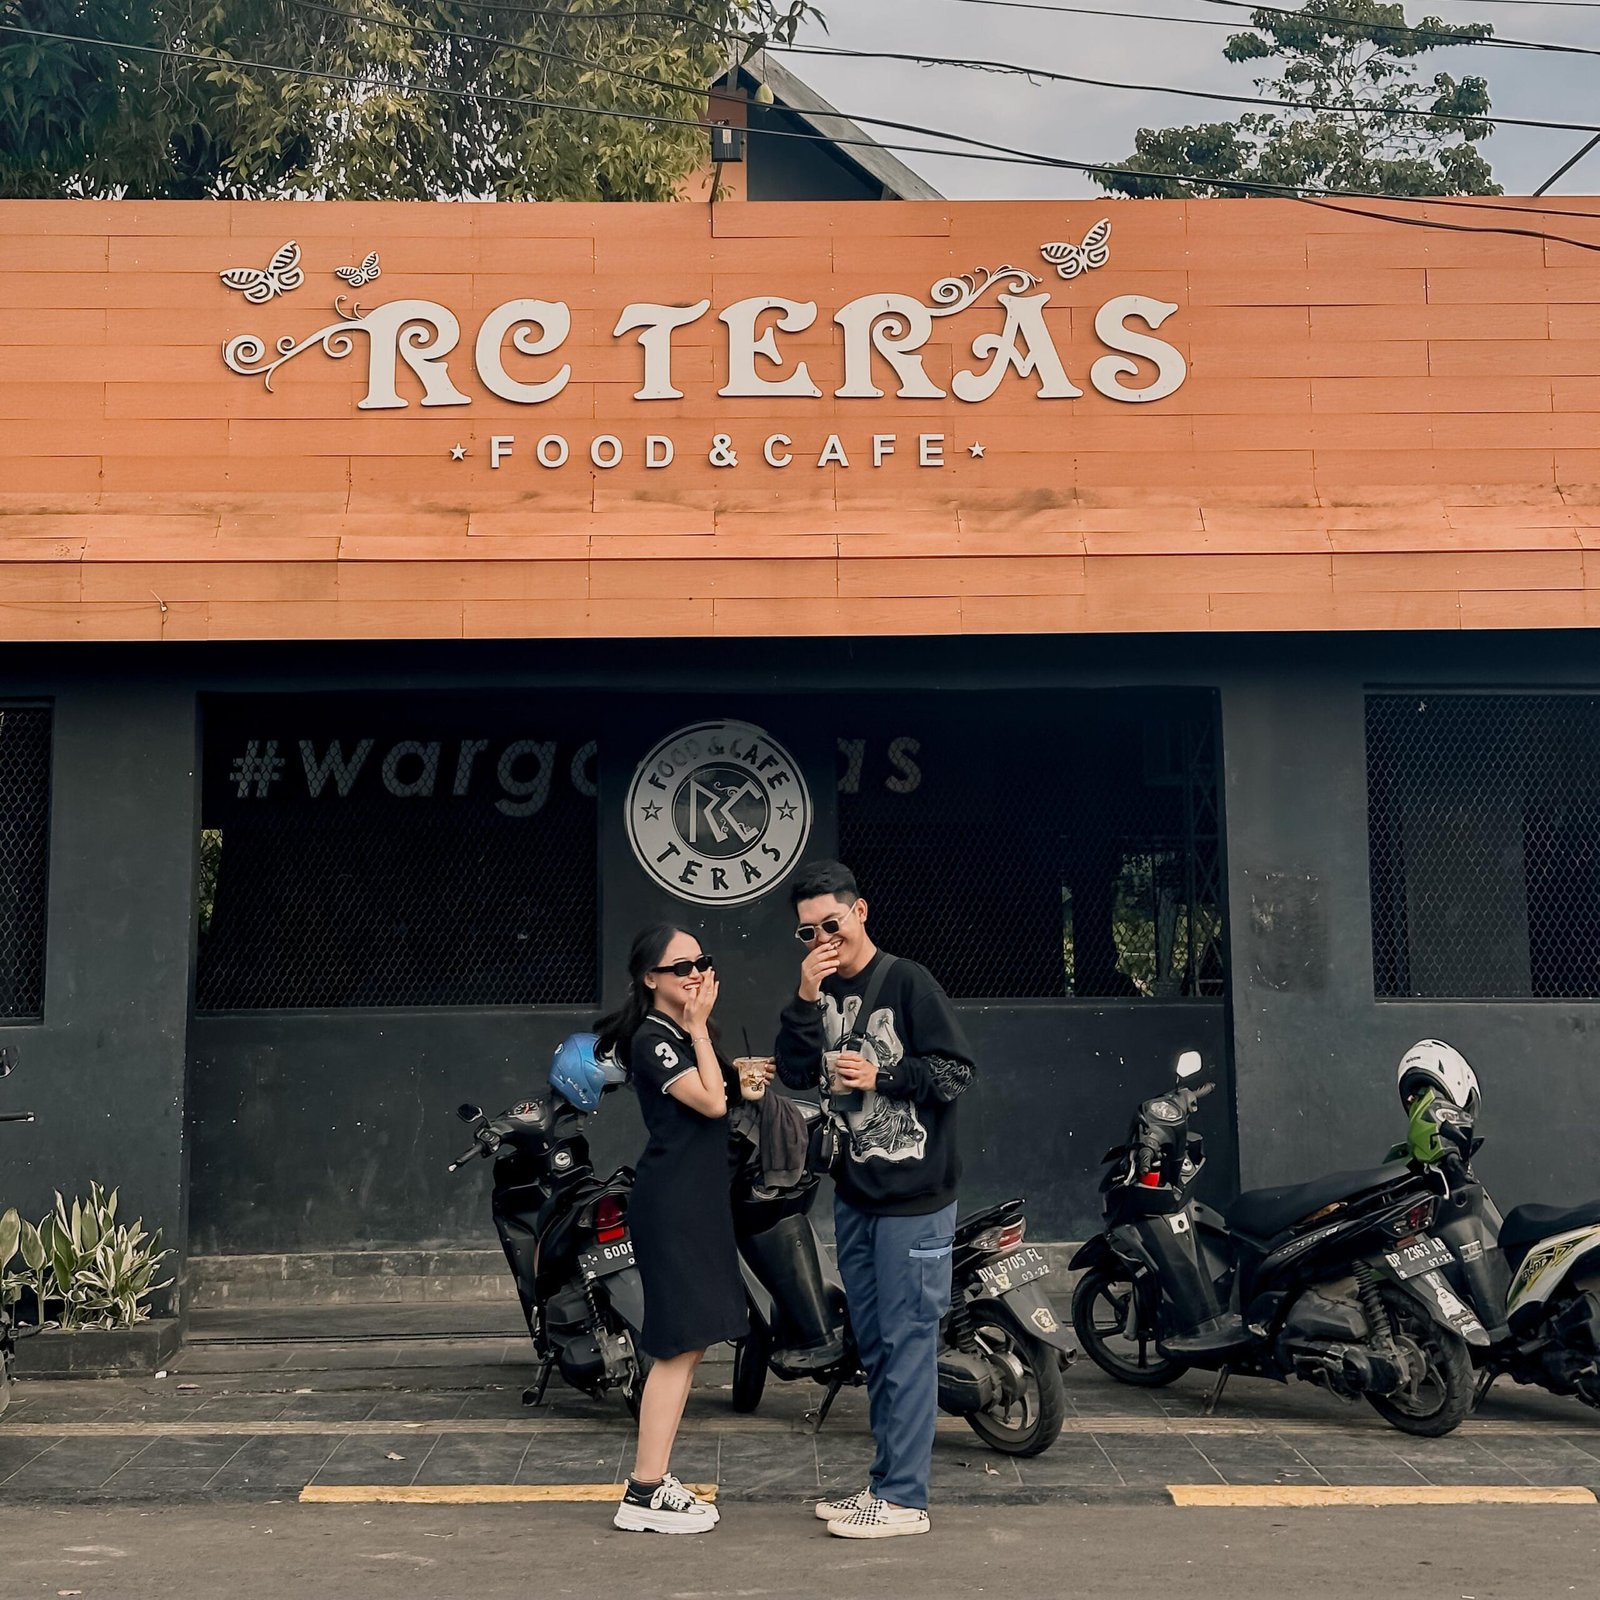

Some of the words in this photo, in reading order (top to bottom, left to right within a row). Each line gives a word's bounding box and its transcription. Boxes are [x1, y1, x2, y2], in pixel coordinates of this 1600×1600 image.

[357, 297, 572, 409] RC
[612, 293, 1188, 404] TERAS
[490, 433, 676, 469] FOOD
[708, 433, 739, 468] &
[762, 433, 946, 468] CAFE
[647, 738, 702, 792] FOOD
[729, 736, 791, 791] CAFE
[688, 779, 764, 844] RC
[656, 841, 782, 891] TERAS
[654, 1041, 679, 1069] 3
[997, 1252, 1027, 1274] 6705
[1025, 1247, 1043, 1263] FL
[1403, 1242, 1431, 1261] 2363
